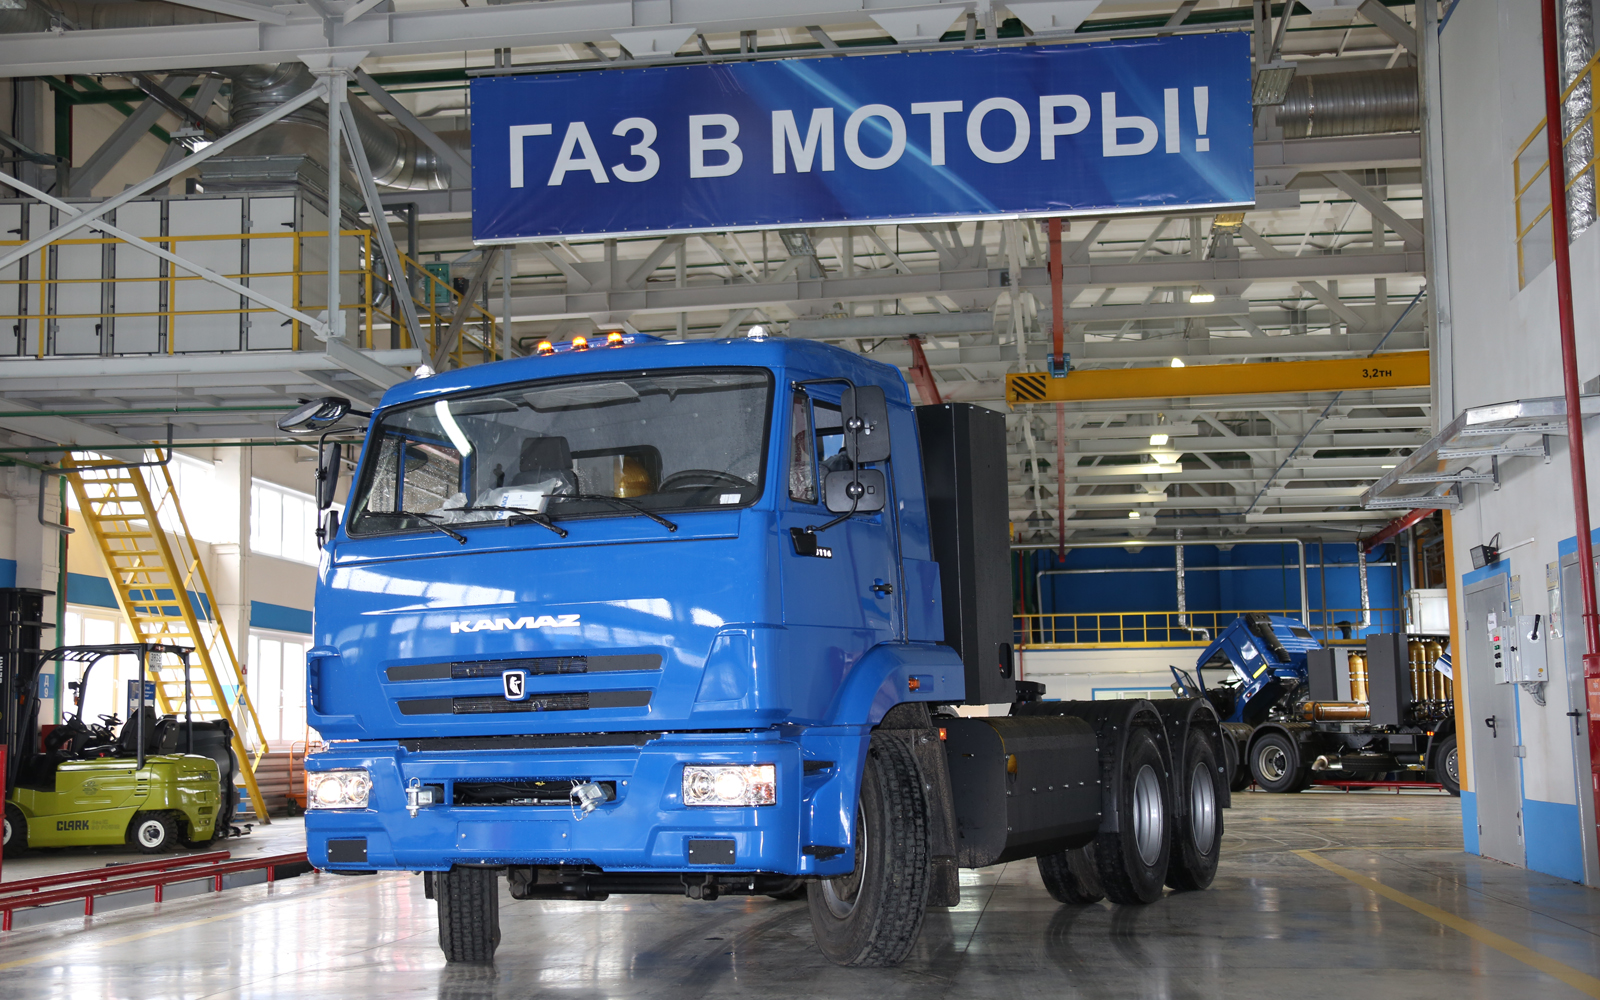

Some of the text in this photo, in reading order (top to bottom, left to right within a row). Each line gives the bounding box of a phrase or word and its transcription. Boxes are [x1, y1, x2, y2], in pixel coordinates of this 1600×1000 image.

[509, 86, 1210, 188] ГАЗ В МОТОРЫ!
[1362, 368, 1392, 379] 3,2тн
[451, 614, 581, 634] KAMAZ
[56, 820, 89, 831] CLARK
